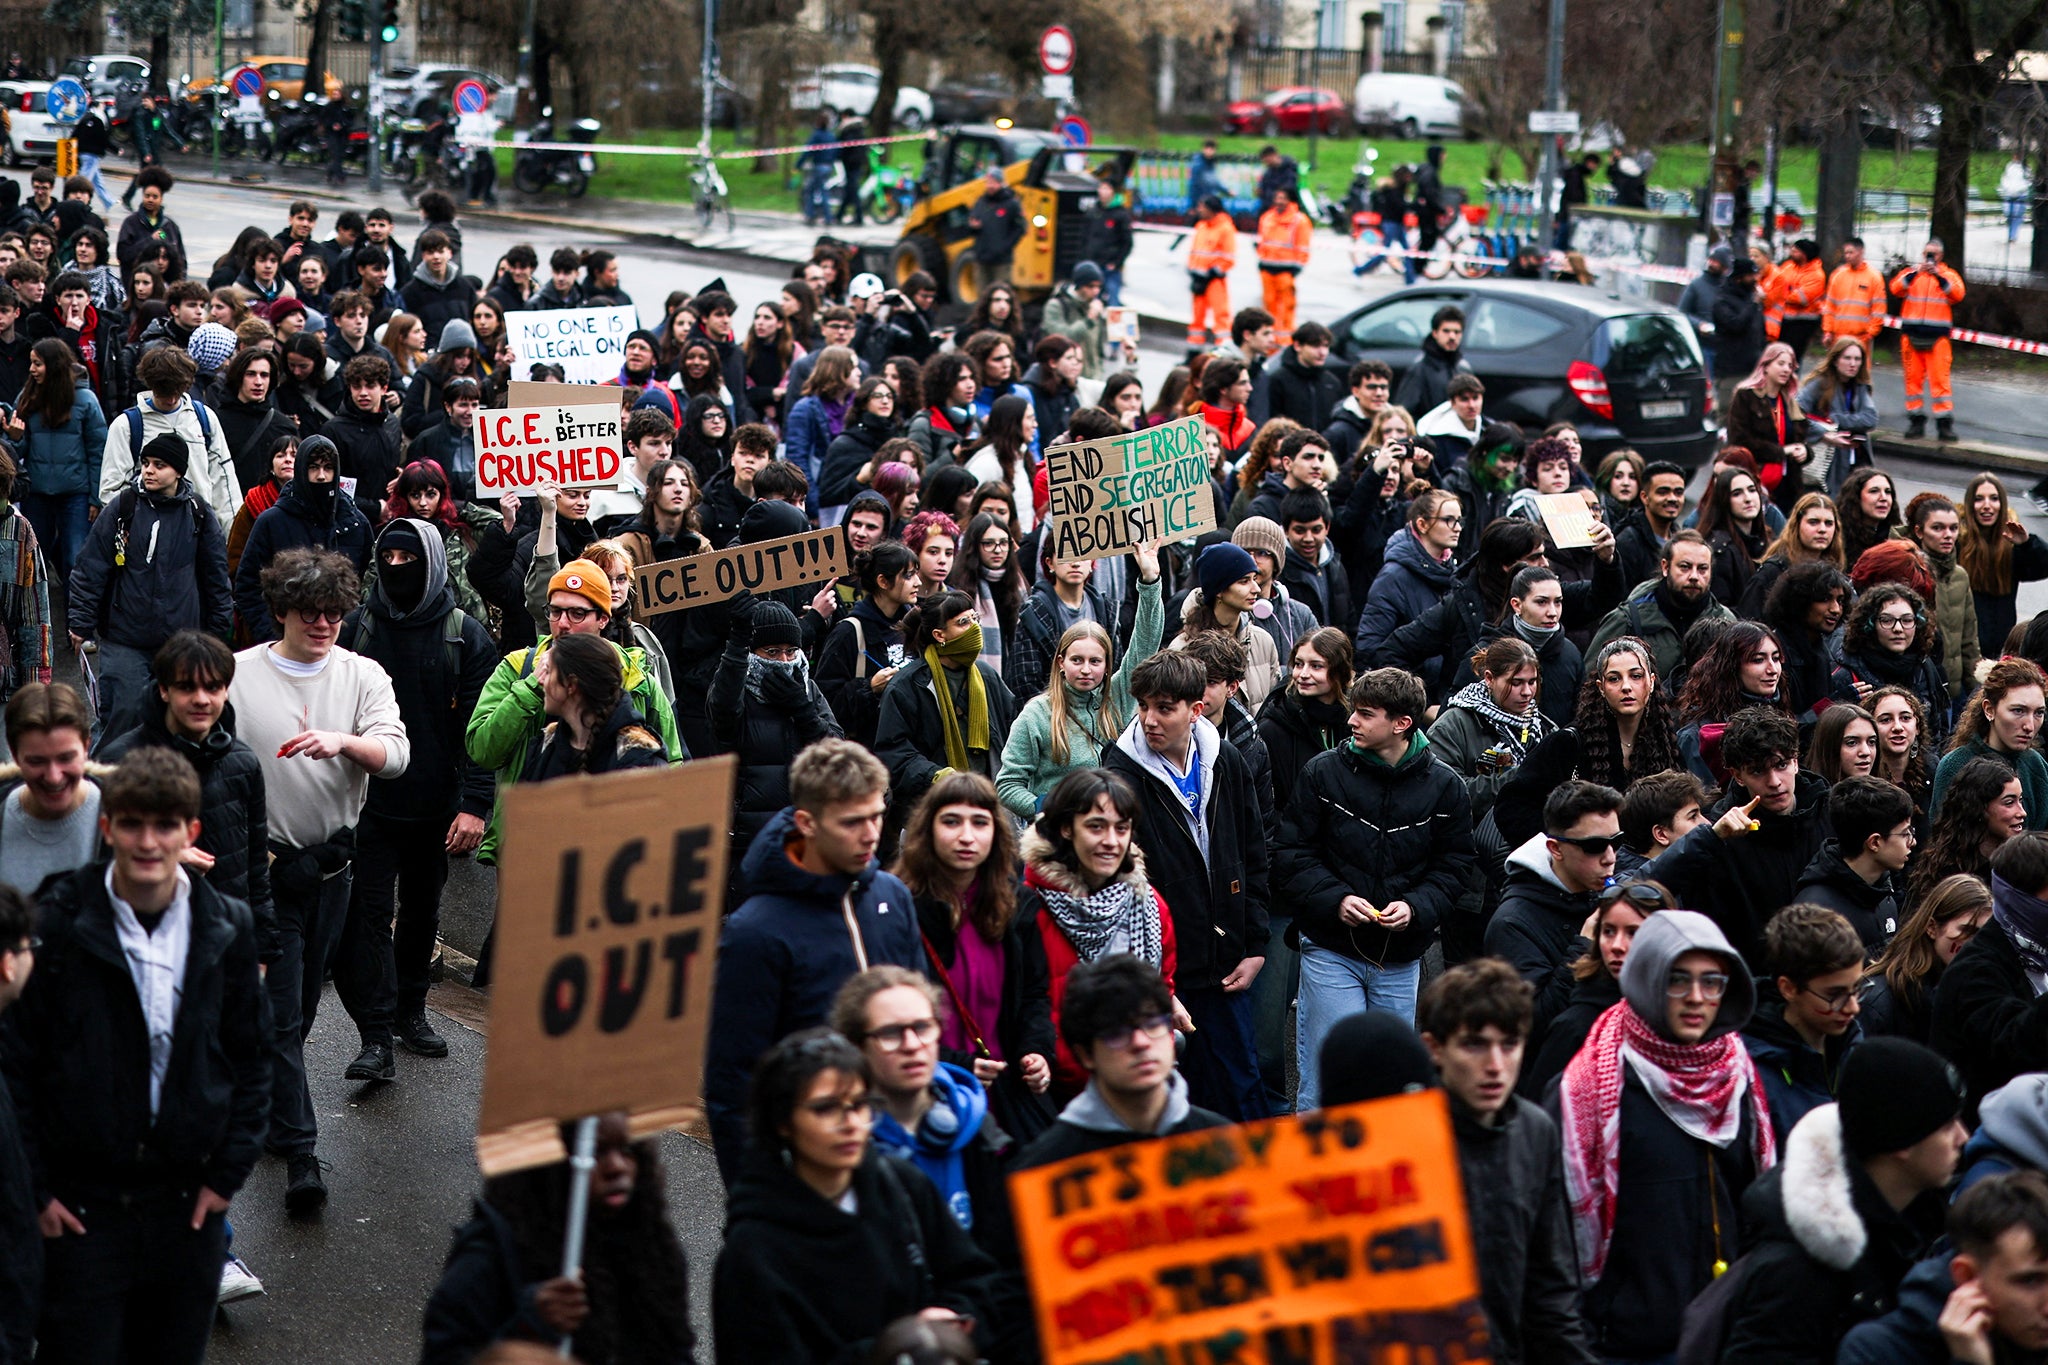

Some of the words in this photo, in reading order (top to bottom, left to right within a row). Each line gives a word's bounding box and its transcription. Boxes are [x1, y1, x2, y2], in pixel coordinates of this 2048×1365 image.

[522, 339, 591, 360] ILLEGAL
[596, 337, 622, 354] ON
[523, 322, 550, 340] NO
[557, 316, 598, 335] ONE
[608, 315, 624, 334] IS
[478, 413, 550, 449] I.C.E.
[557, 408, 574, 424] is
[555, 422, 617, 442] BETTER
[478, 446, 620, 488] CRUSHED
[1047, 447, 1104, 486] END
[1111, 420, 1205, 472] TERROR
[1050, 483, 1094, 516] END
[1057, 502, 1158, 559] ABOLISH
[1162, 490, 1204, 537] ICE.
[640, 563, 709, 609] I.C.E.
[714, 534, 836, 594] OUT!!!
[553, 823, 713, 938] I.C.E
[540, 930, 702, 1038] OUT
